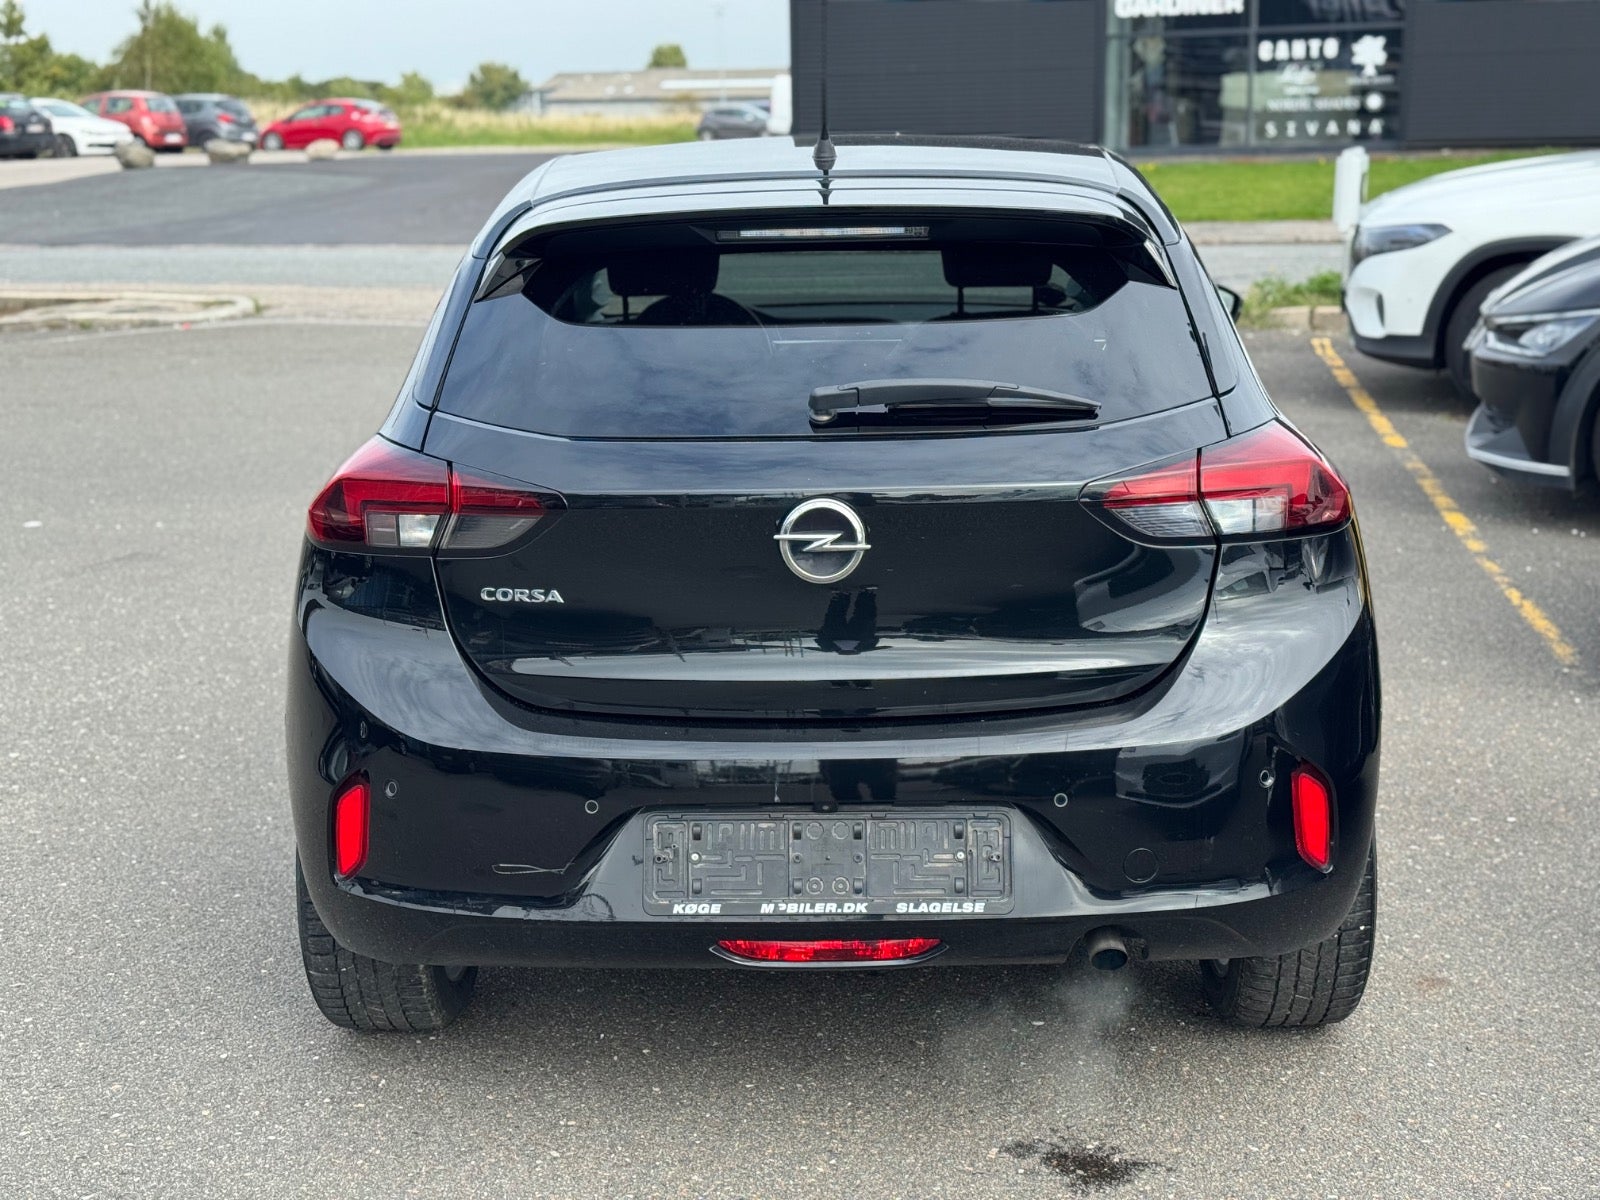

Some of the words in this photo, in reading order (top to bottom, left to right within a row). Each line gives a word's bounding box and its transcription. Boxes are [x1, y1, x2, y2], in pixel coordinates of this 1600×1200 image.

[480, 587, 565, 604] CORSA
[672, 903, 722, 915] KØGE
[895, 902, 986, 914] SLAGELSE
